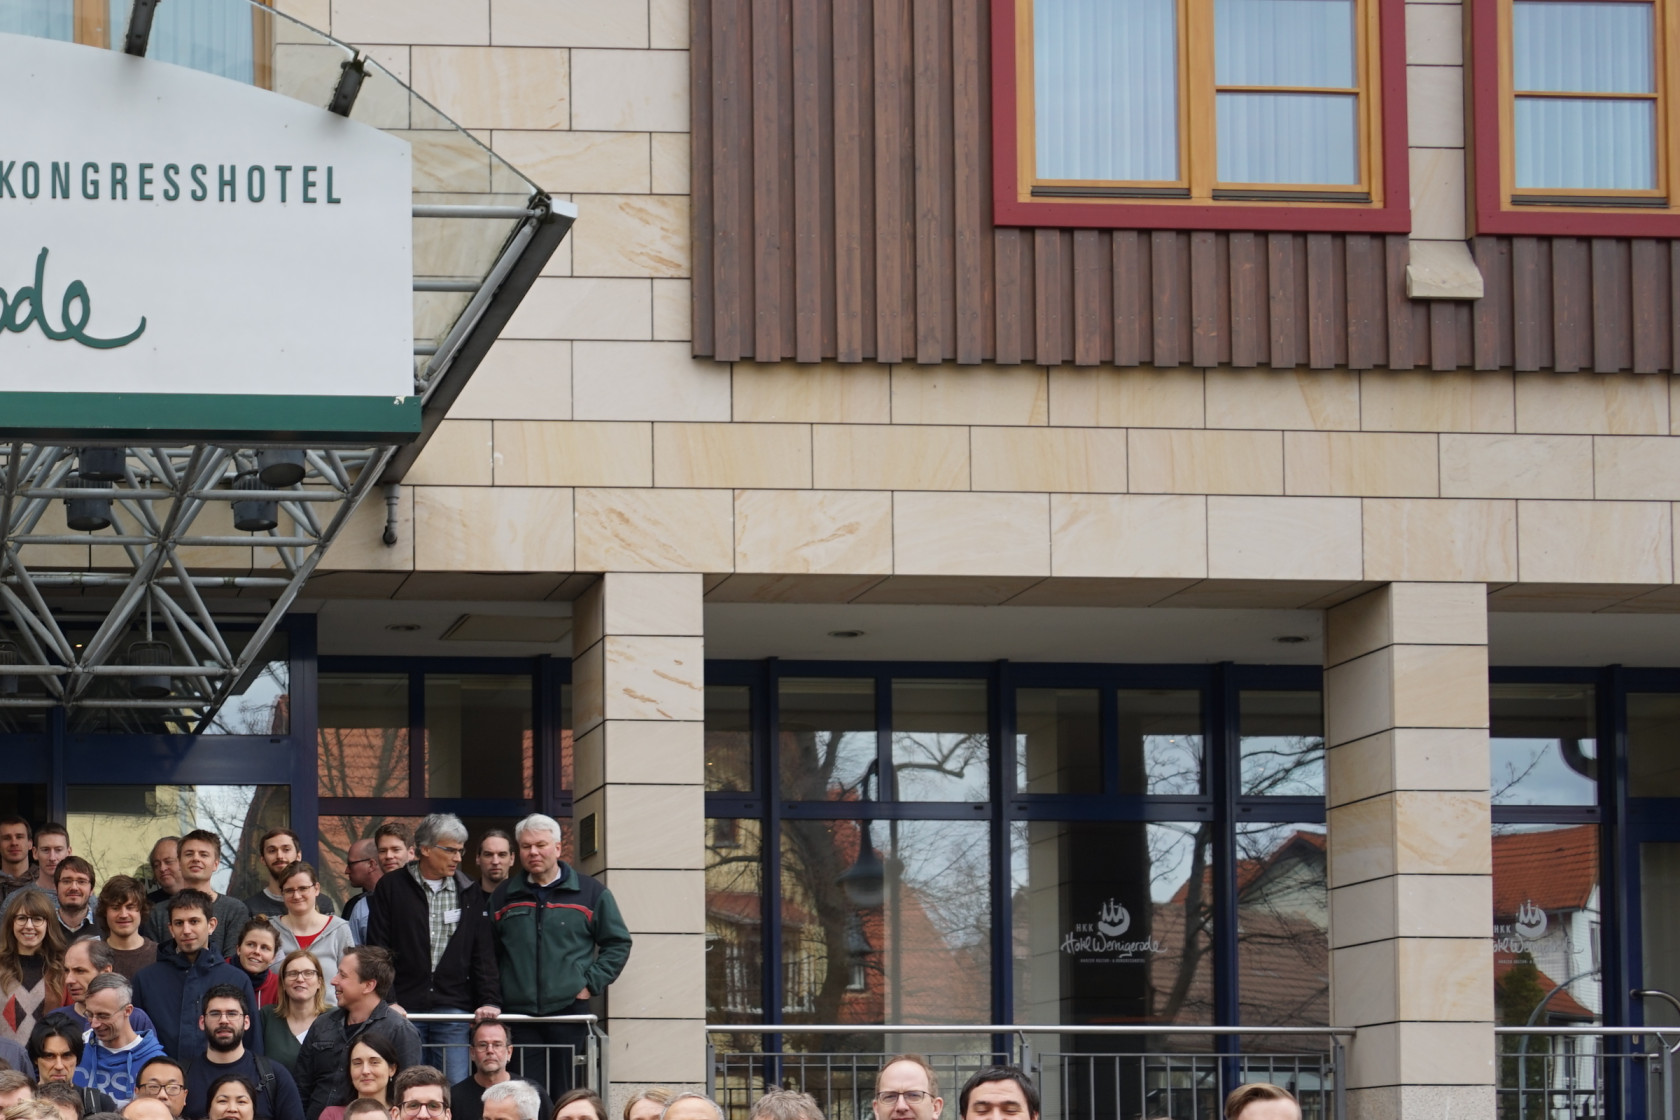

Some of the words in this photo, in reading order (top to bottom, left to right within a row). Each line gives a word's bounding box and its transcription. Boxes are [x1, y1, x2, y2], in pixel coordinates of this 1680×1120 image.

[1076, 923, 1094, 932] HKK
[1060, 932, 1092, 955] Hotel
[1093, 932, 1168, 958] Wernigerode
